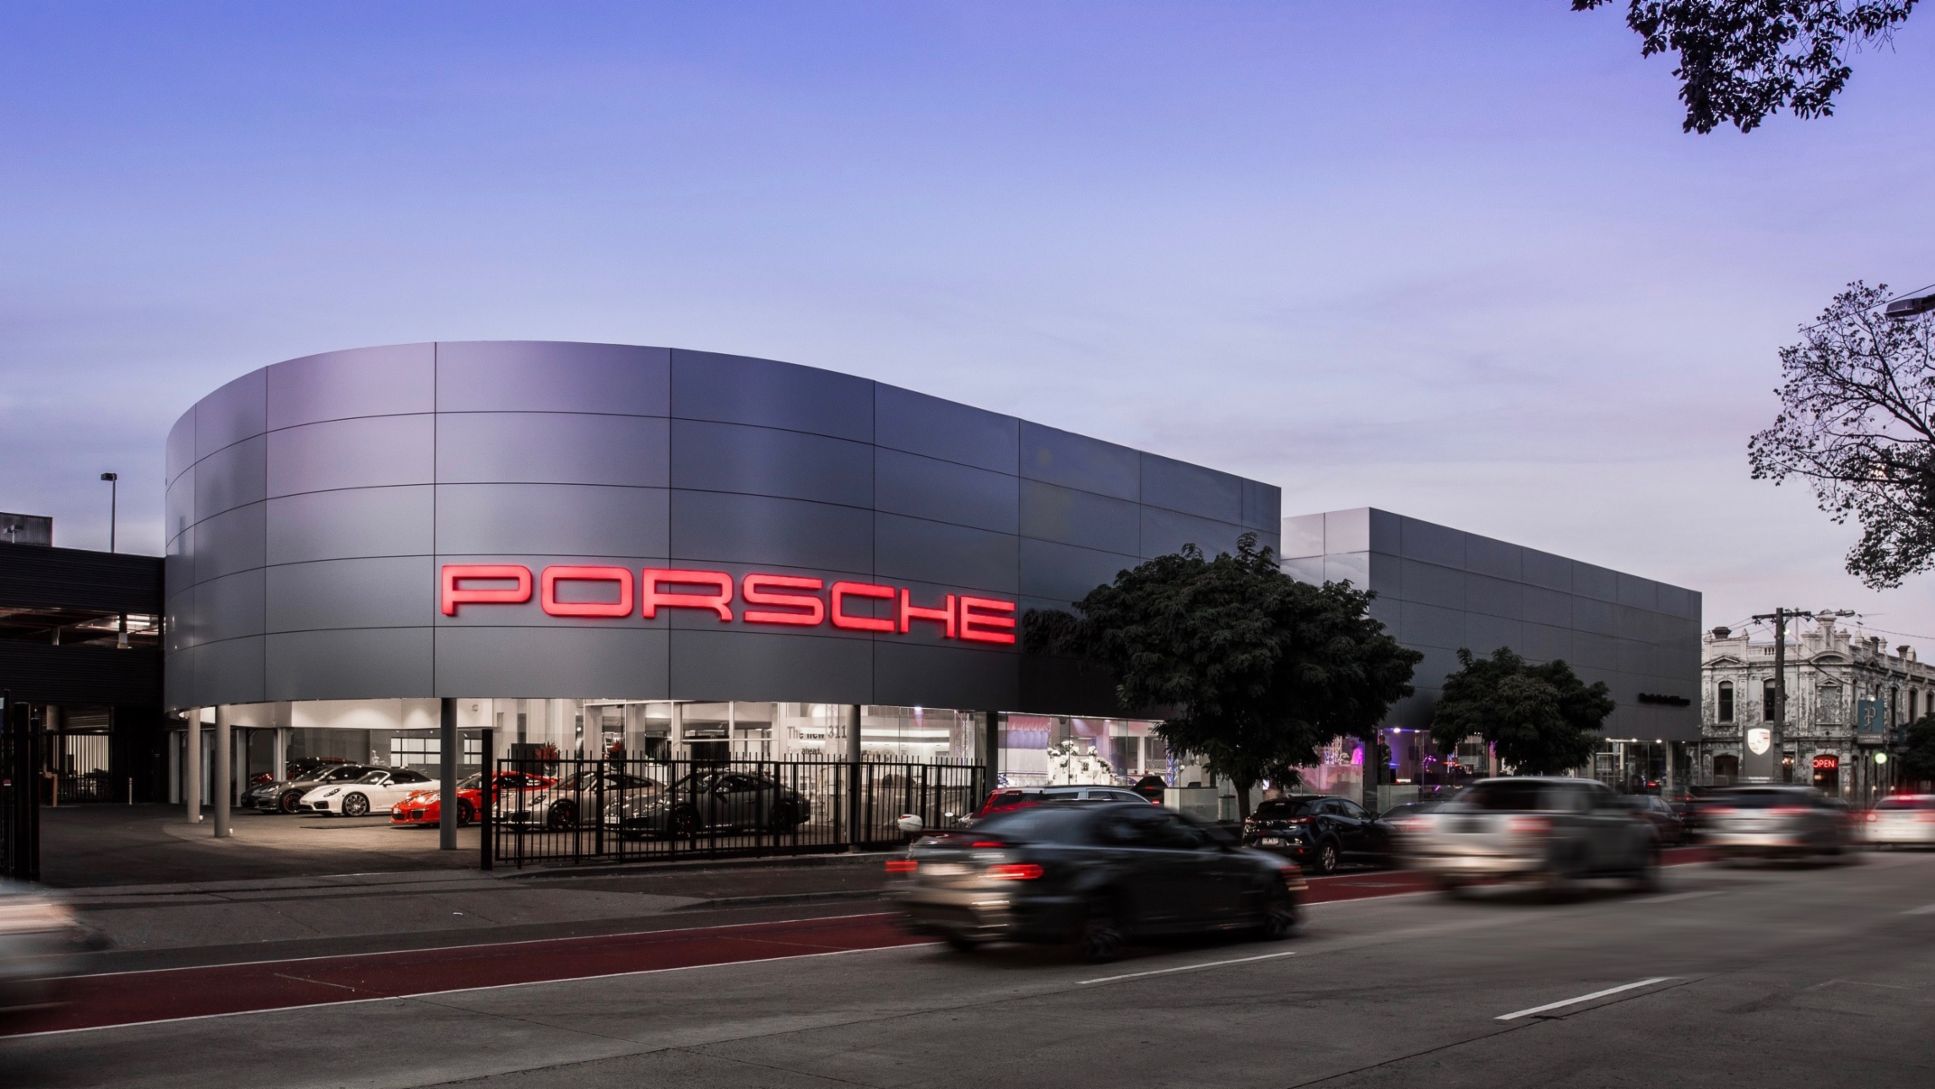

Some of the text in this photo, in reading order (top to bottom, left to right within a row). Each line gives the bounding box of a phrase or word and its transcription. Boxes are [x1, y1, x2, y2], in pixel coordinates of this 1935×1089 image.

[441, 564, 1016, 644] PORSCHE
[787, 726, 804, 739] The
[1813, 759, 1835, 768] OPEN
